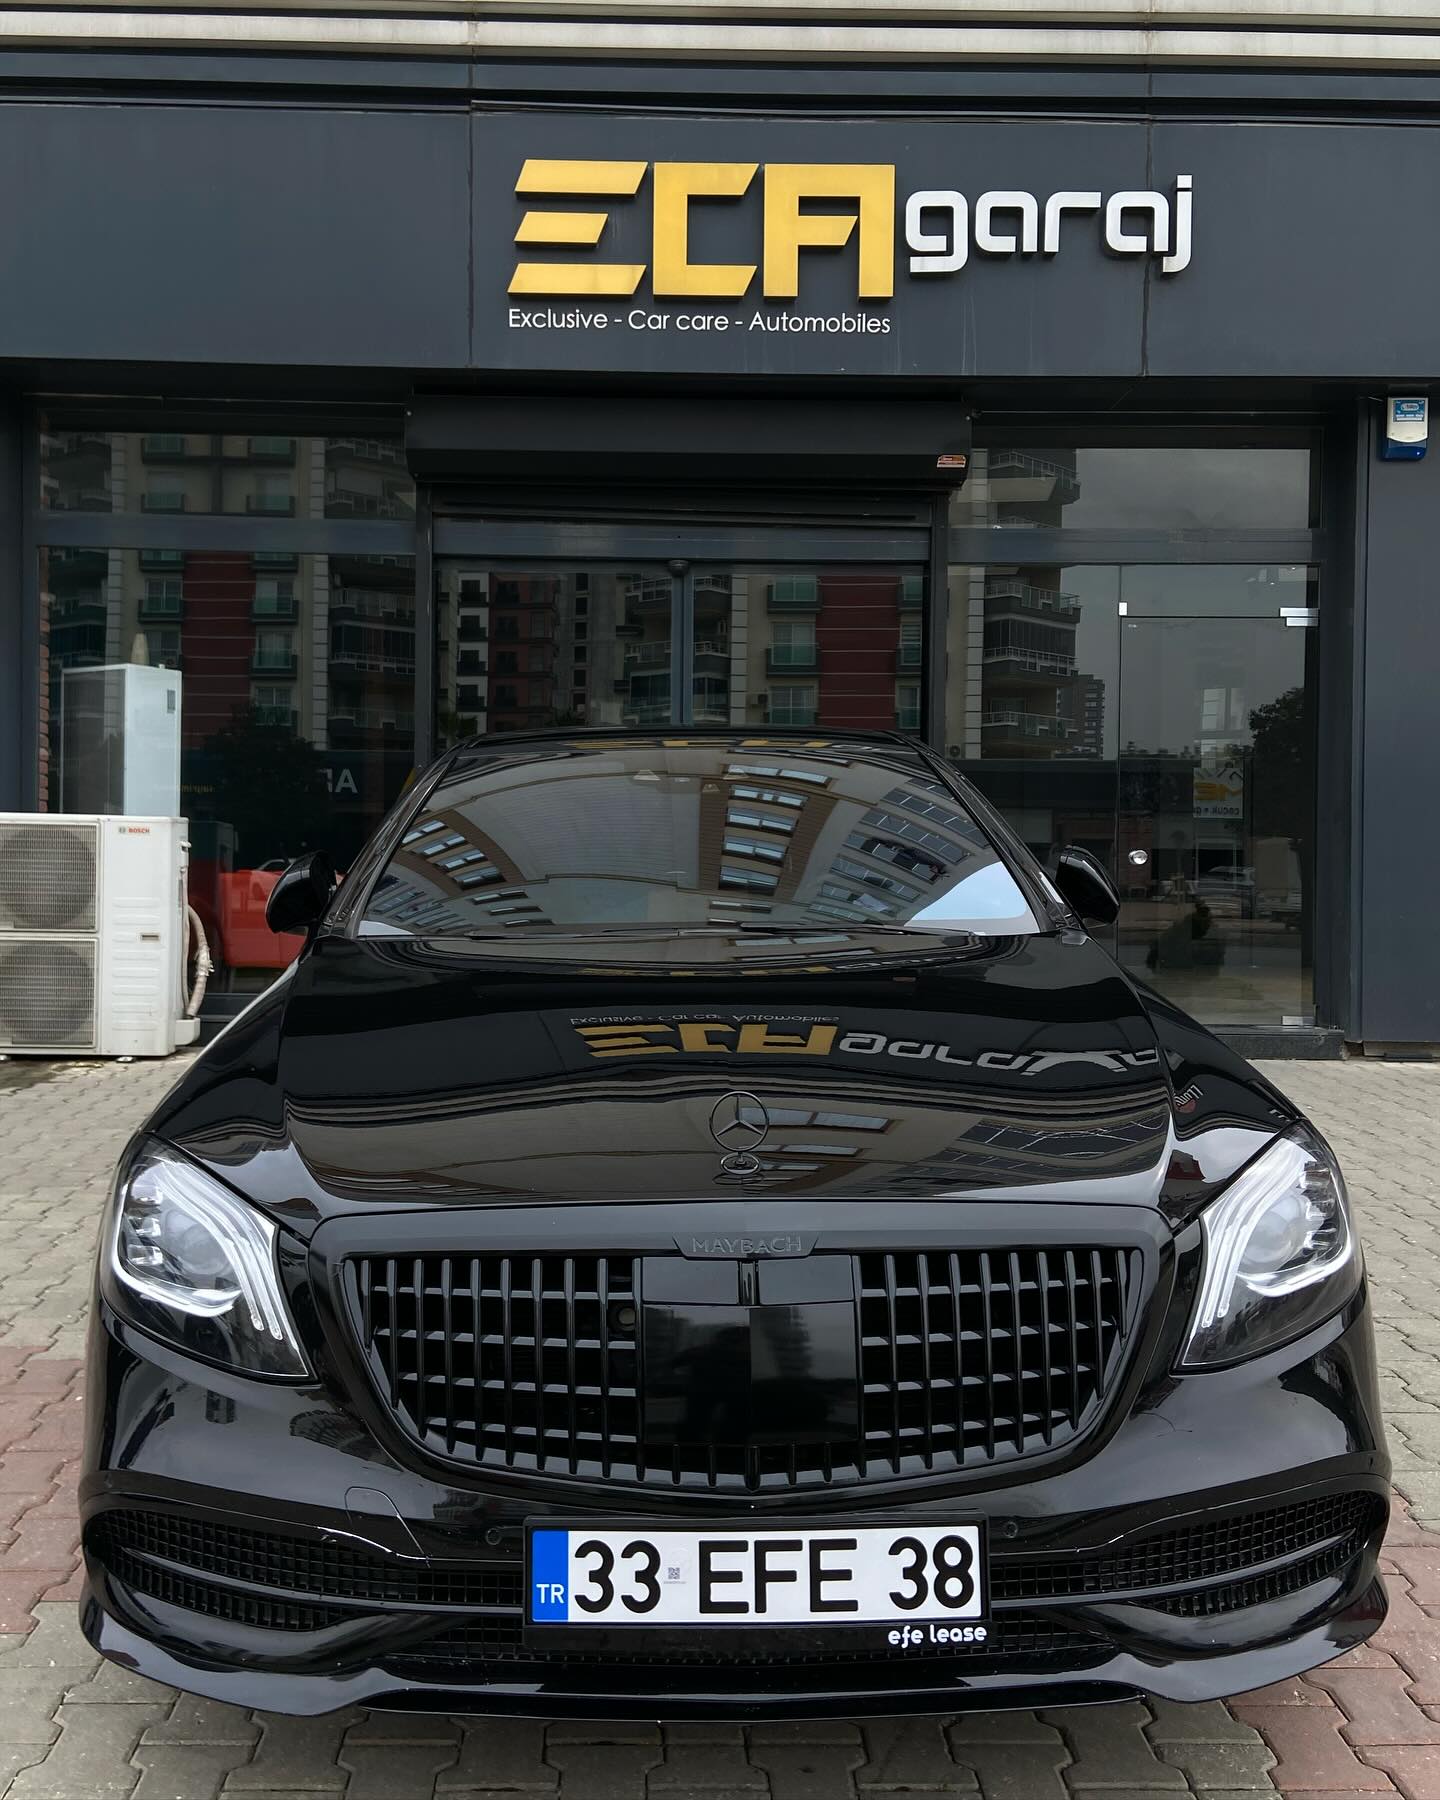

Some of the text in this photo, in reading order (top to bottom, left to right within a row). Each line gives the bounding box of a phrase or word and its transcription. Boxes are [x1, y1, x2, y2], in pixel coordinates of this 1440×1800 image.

[508, 159, 1193, 299] ECA garaj
[508, 308, 608, 329] Exclusive
[628, 309, 670, 330] Car
[676, 314, 729, 331] care
[749, 311, 891, 333] Automobiles
[692, 1236, 802, 1254] MAYBACH
[536, 1535, 975, 1614] TR 33 EFE 38
[888, 1624, 987, 1649] efe lease
